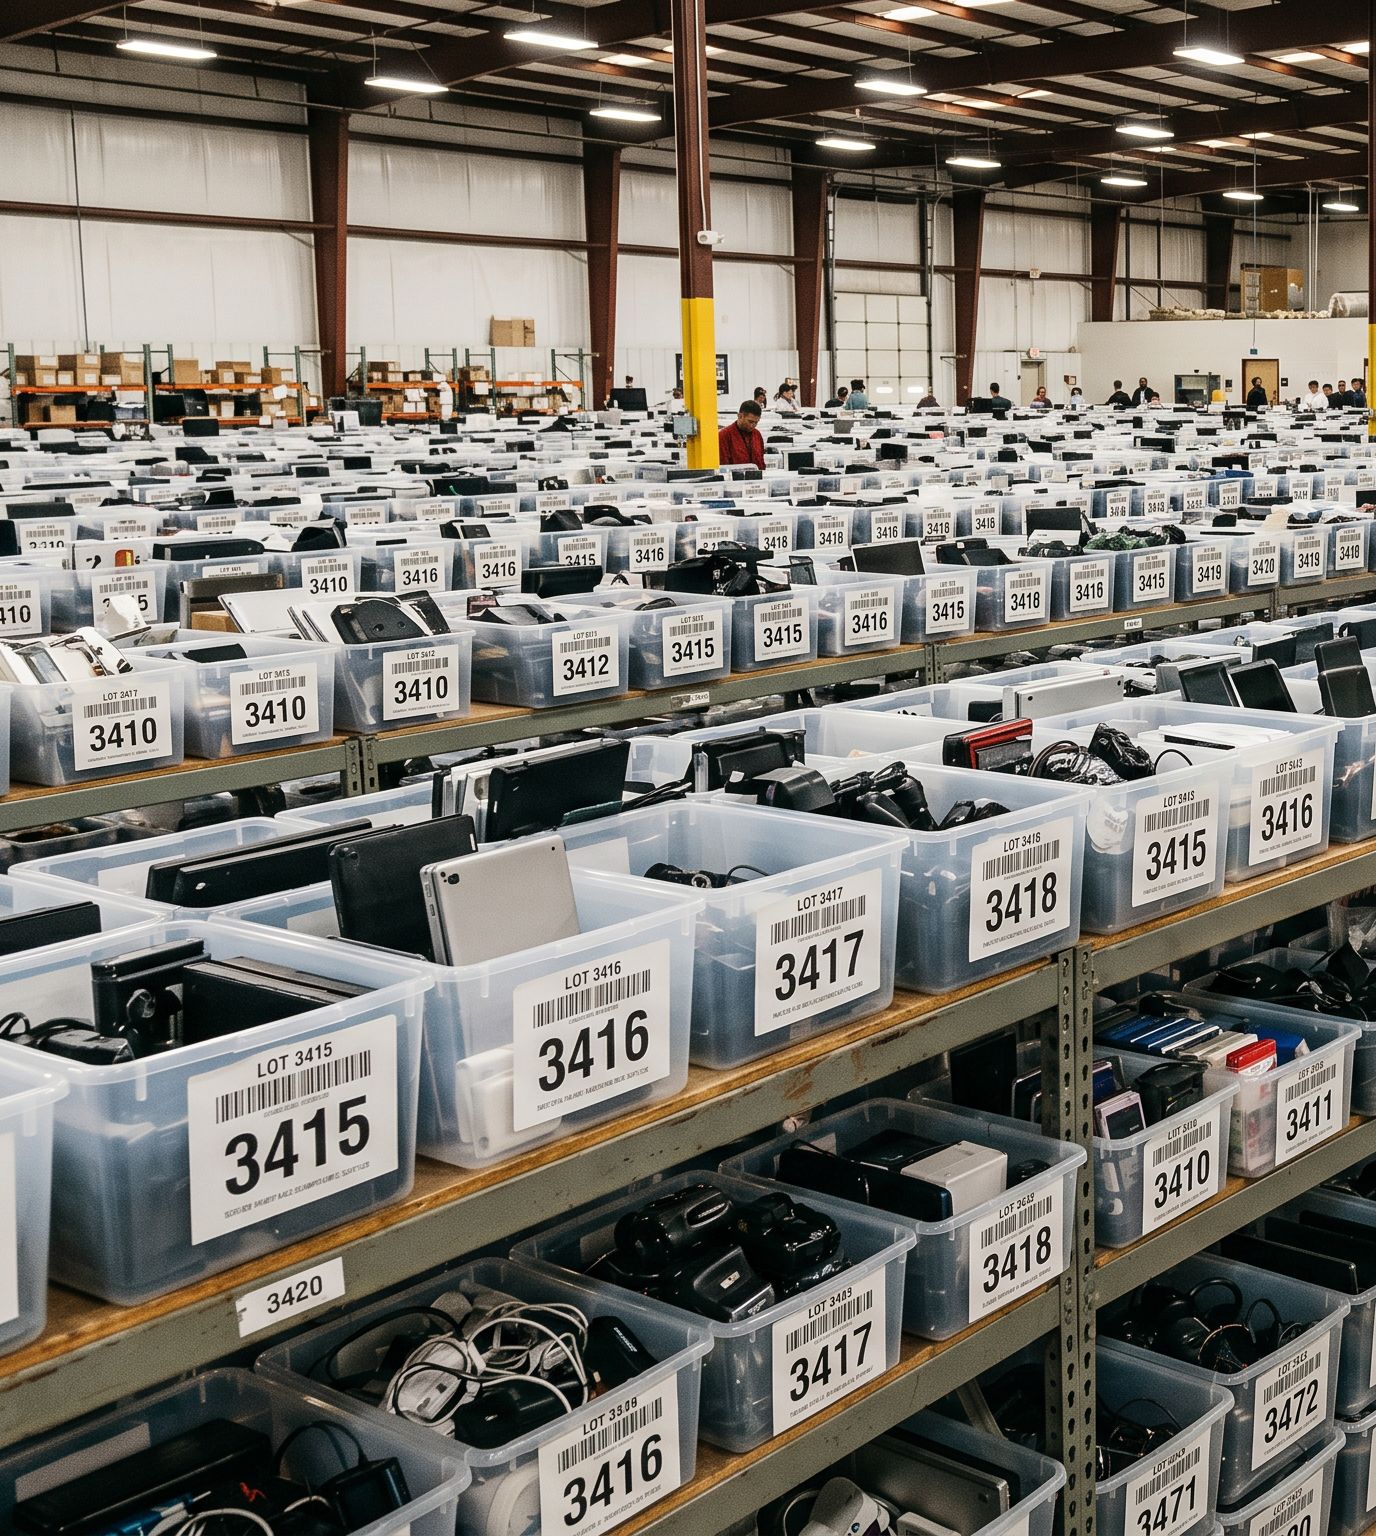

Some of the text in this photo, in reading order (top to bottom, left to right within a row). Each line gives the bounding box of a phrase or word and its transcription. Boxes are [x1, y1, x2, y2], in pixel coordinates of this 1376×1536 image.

[876, 525, 898, 539] 3416
[927, 522, 950, 535] 3418
[975, 517, 995, 530] 3418
[764, 535, 788, 549] 3418
[819, 531, 843, 545] 3418
[636, 547, 664, 563] 3416
[403, 568, 438, 586] 3416
[482, 561, 516, 579] 3416
[1197, 564, 1221, 583] 3419
[1252, 558, 1275, 575] 3420
[310, 576, 347, 594] 3410
[1076, 582, 1103, 601] 3416
[1139, 572, 1165, 591] 3415
[933, 600, 964, 622] 3415
[1011, 591, 1040, 611] 3418
[0, 605, 31, 625] 410
[852, 611, 887, 634] 3416
[763, 623, 802, 648] 3415
[407, 652, 419, 660] LOT
[672, 637, 714, 663] 3415
[259, 671, 273, 680] LOT
[563, 654, 609, 681] 3412
[103, 692, 118, 701] LOT
[394, 675, 448, 704] 3410
[245, 695, 306, 727] 3410
[89, 717, 157, 752] 3410
[1276, 762, 1288, 774] LOT
[1164, 795, 1177, 808] LOT
[1261, 793, 1312, 841] 3416
[1004, 832, 1041, 853] LOT 3418
[1146, 828, 1206, 881] 3415
[797, 886, 843, 912] LOT 3417
[986, 872, 1057, 932] 3418
[565, 961, 621, 990] LOT 3416
[775, 929, 864, 1001] 3417
[258, 1041, 332, 1078] LOT 3415
[539, 1010, 649, 1092] 3416
[1286, 1087, 1331, 1141] 3411
[225, 1094, 370, 1195] 3415
[1154, 1147, 1210, 1208] 3410
[983, 1224, 1051, 1293] 3418
[267, 1276, 322, 1314] 3420
[808, 1299, 827, 1319] LOT
[790, 1321, 872, 1401] 3417
[1264, 1375, 1318, 1443] 3472
[583, 1413, 606, 1435] LOT
[562, 1434, 662, 1526] 3416
[1137, 1472, 1196, 1536] 3471
